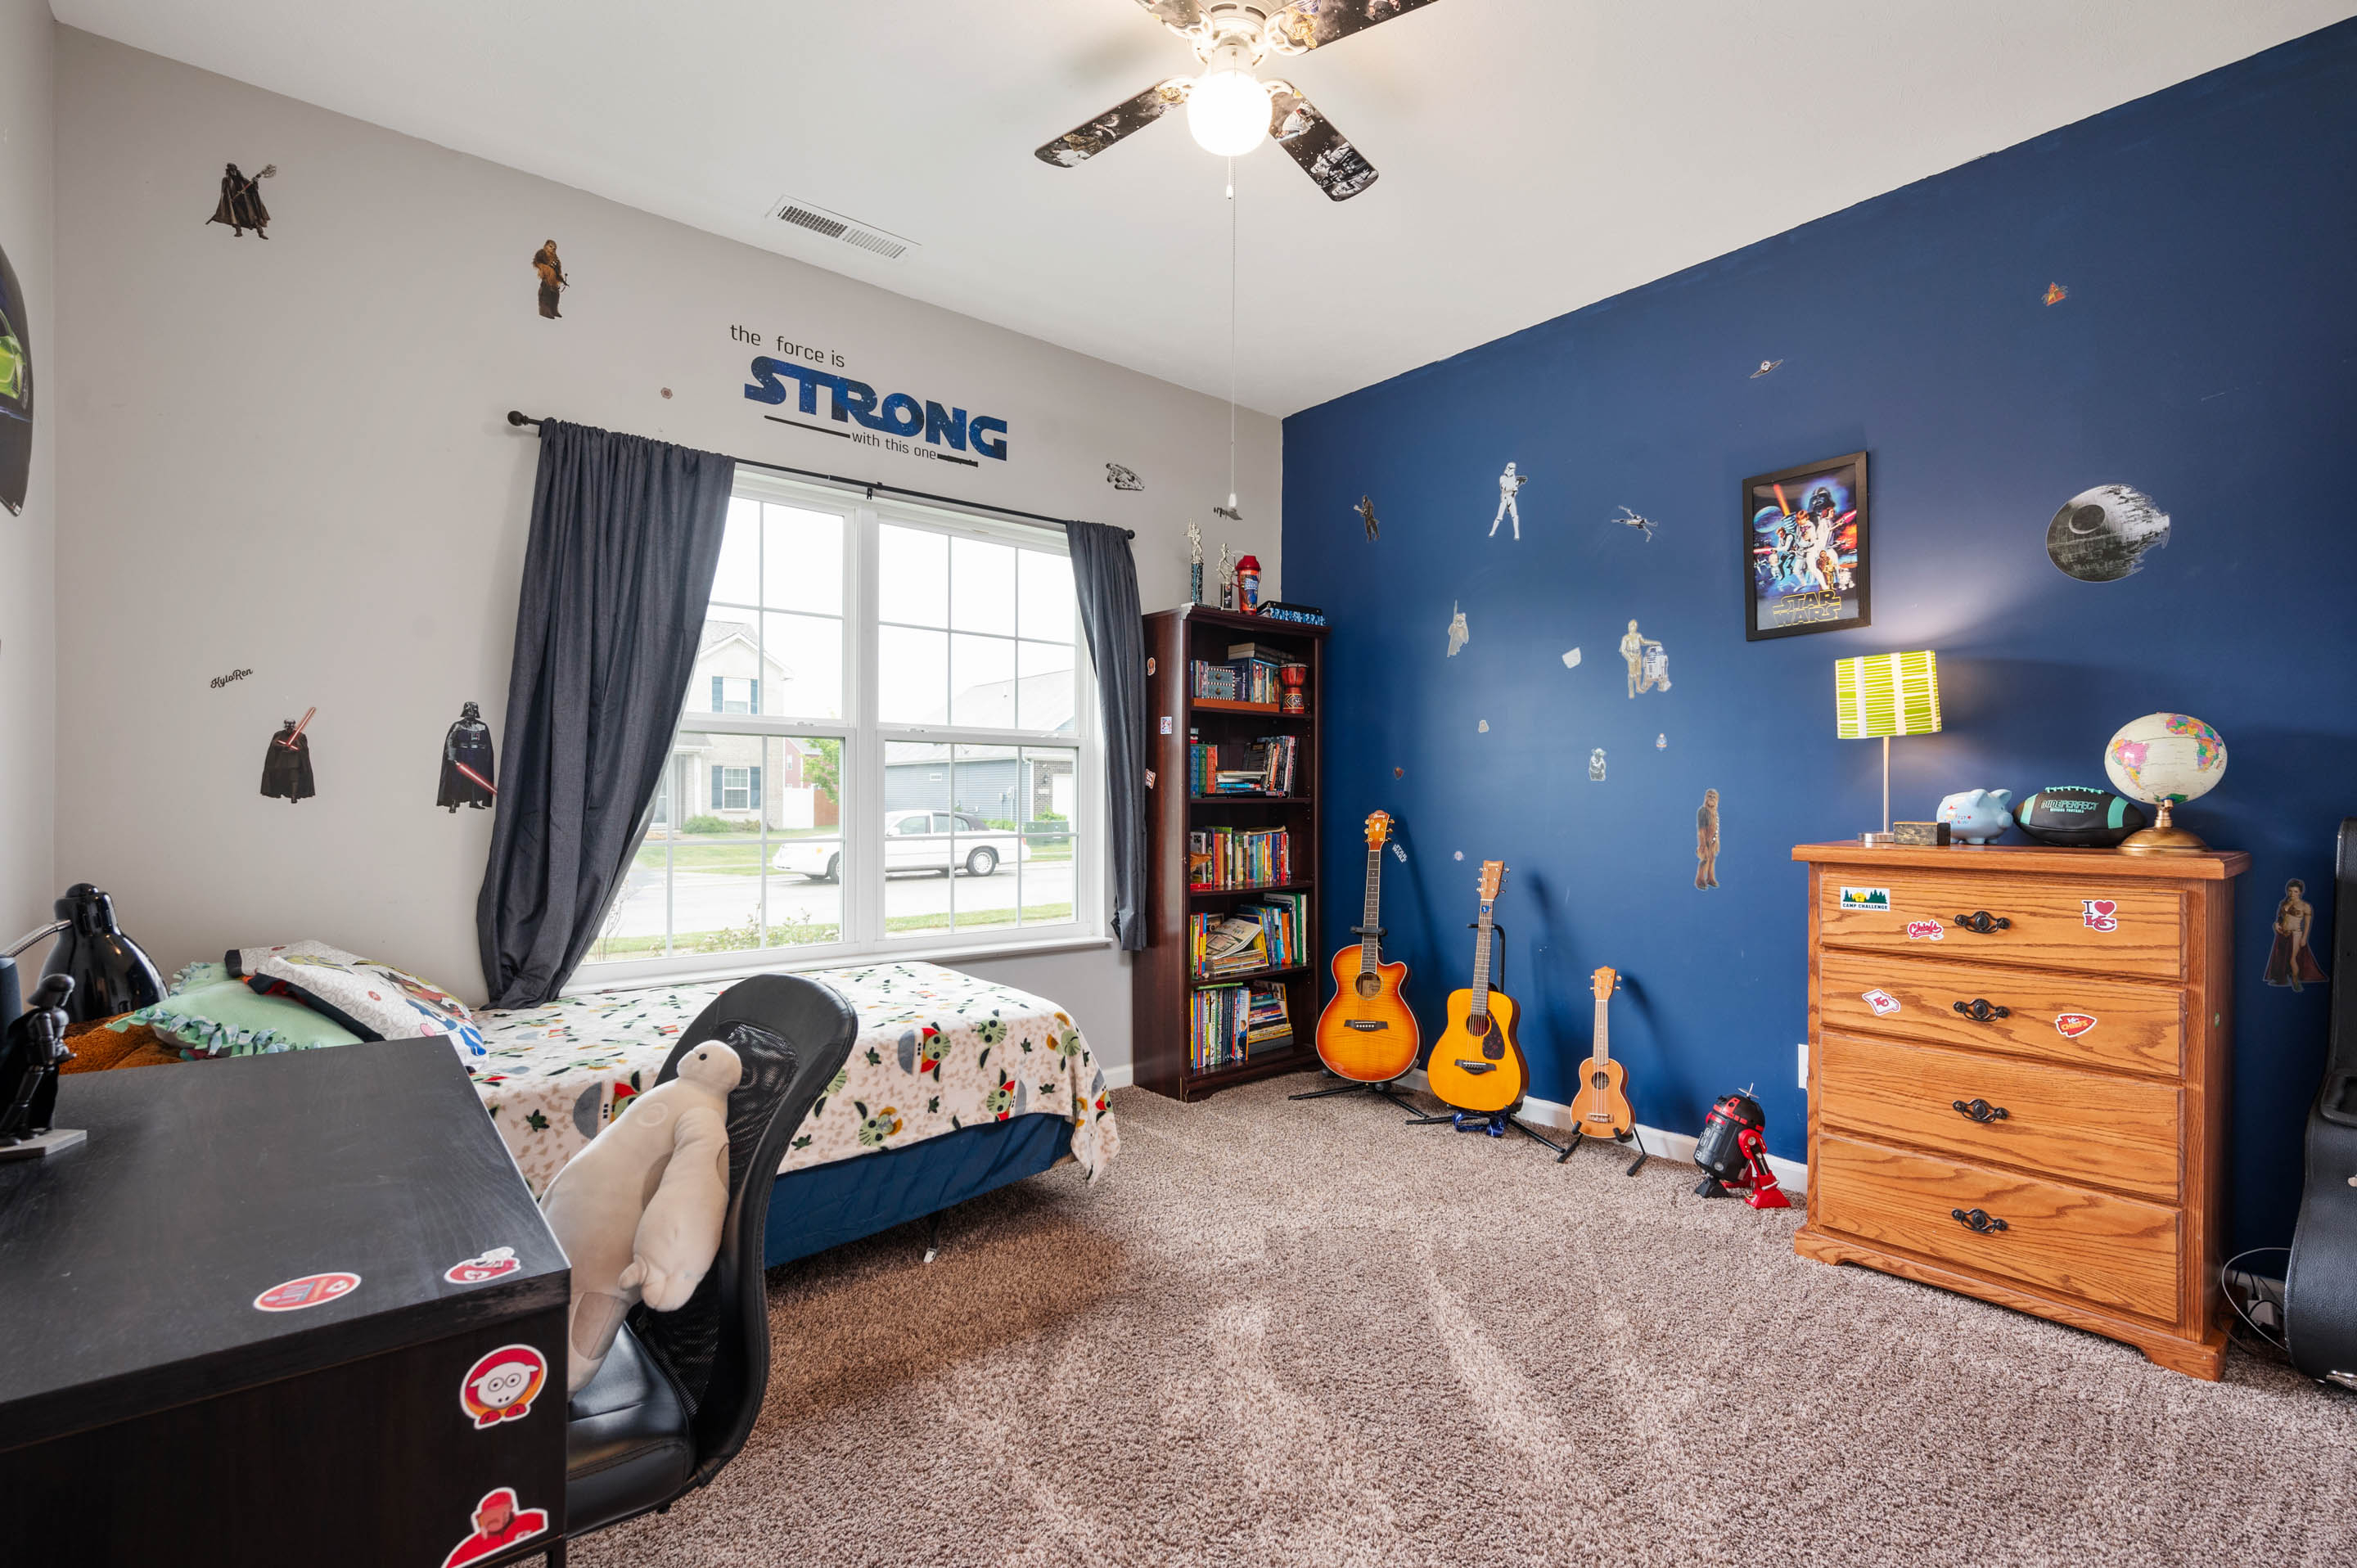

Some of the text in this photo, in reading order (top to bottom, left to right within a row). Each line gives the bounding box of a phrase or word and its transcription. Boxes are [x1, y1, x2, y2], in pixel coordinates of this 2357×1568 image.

[730, 324, 845, 367] the force is
[744, 355, 1007, 462] STRONG
[852, 431, 936, 460] with this one
[1773, 589, 1841, 613] STAR
[1773, 604, 1841, 628] WARS
[2083, 901, 2093, 914] I
